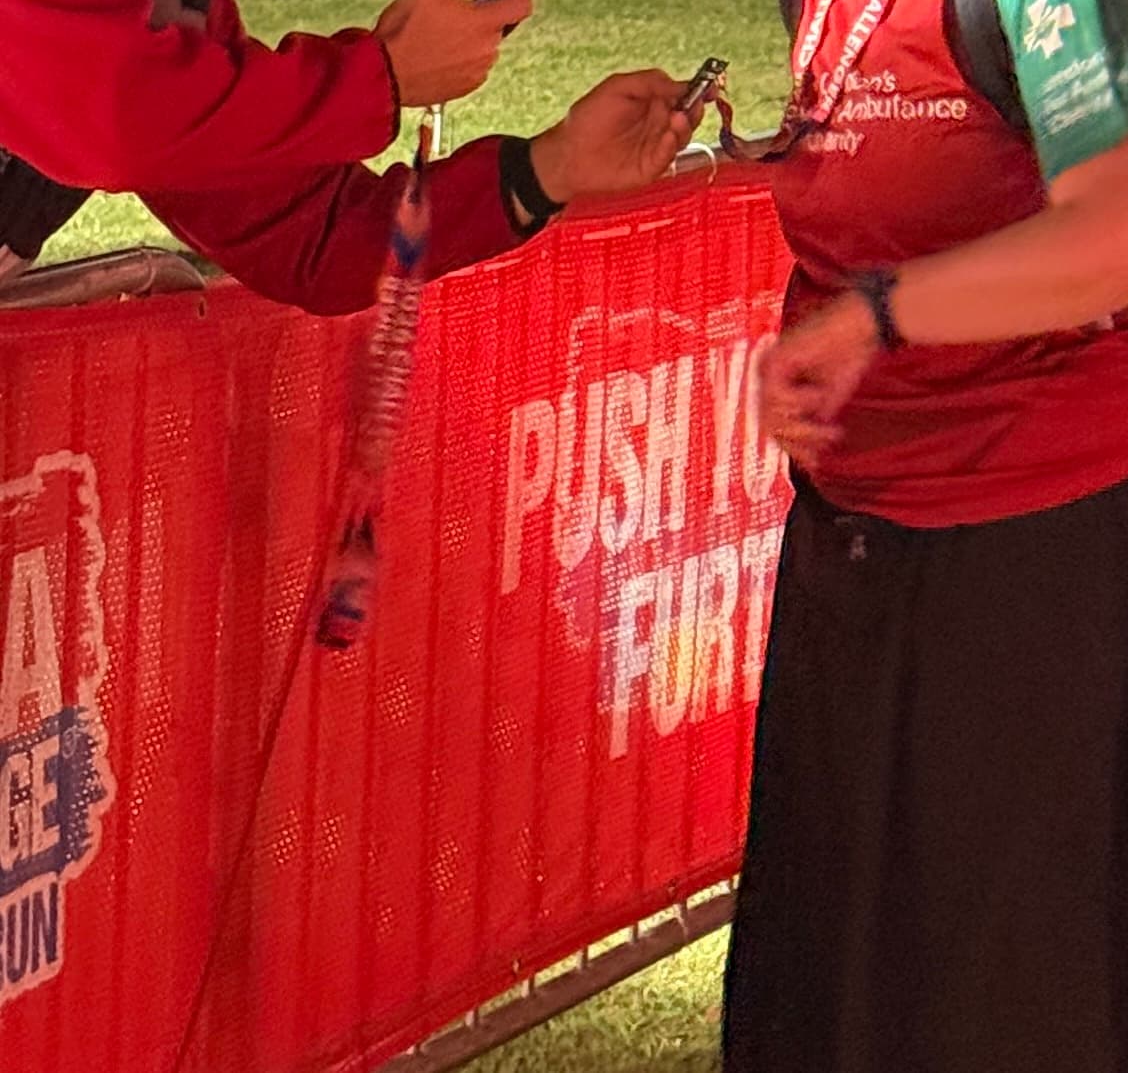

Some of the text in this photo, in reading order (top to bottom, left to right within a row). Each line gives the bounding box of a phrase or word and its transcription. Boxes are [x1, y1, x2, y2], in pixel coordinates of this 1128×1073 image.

[500, 354, 695, 595] PUSH
[707, 333, 790, 515] YO
[0, 881, 59, 991] UN
